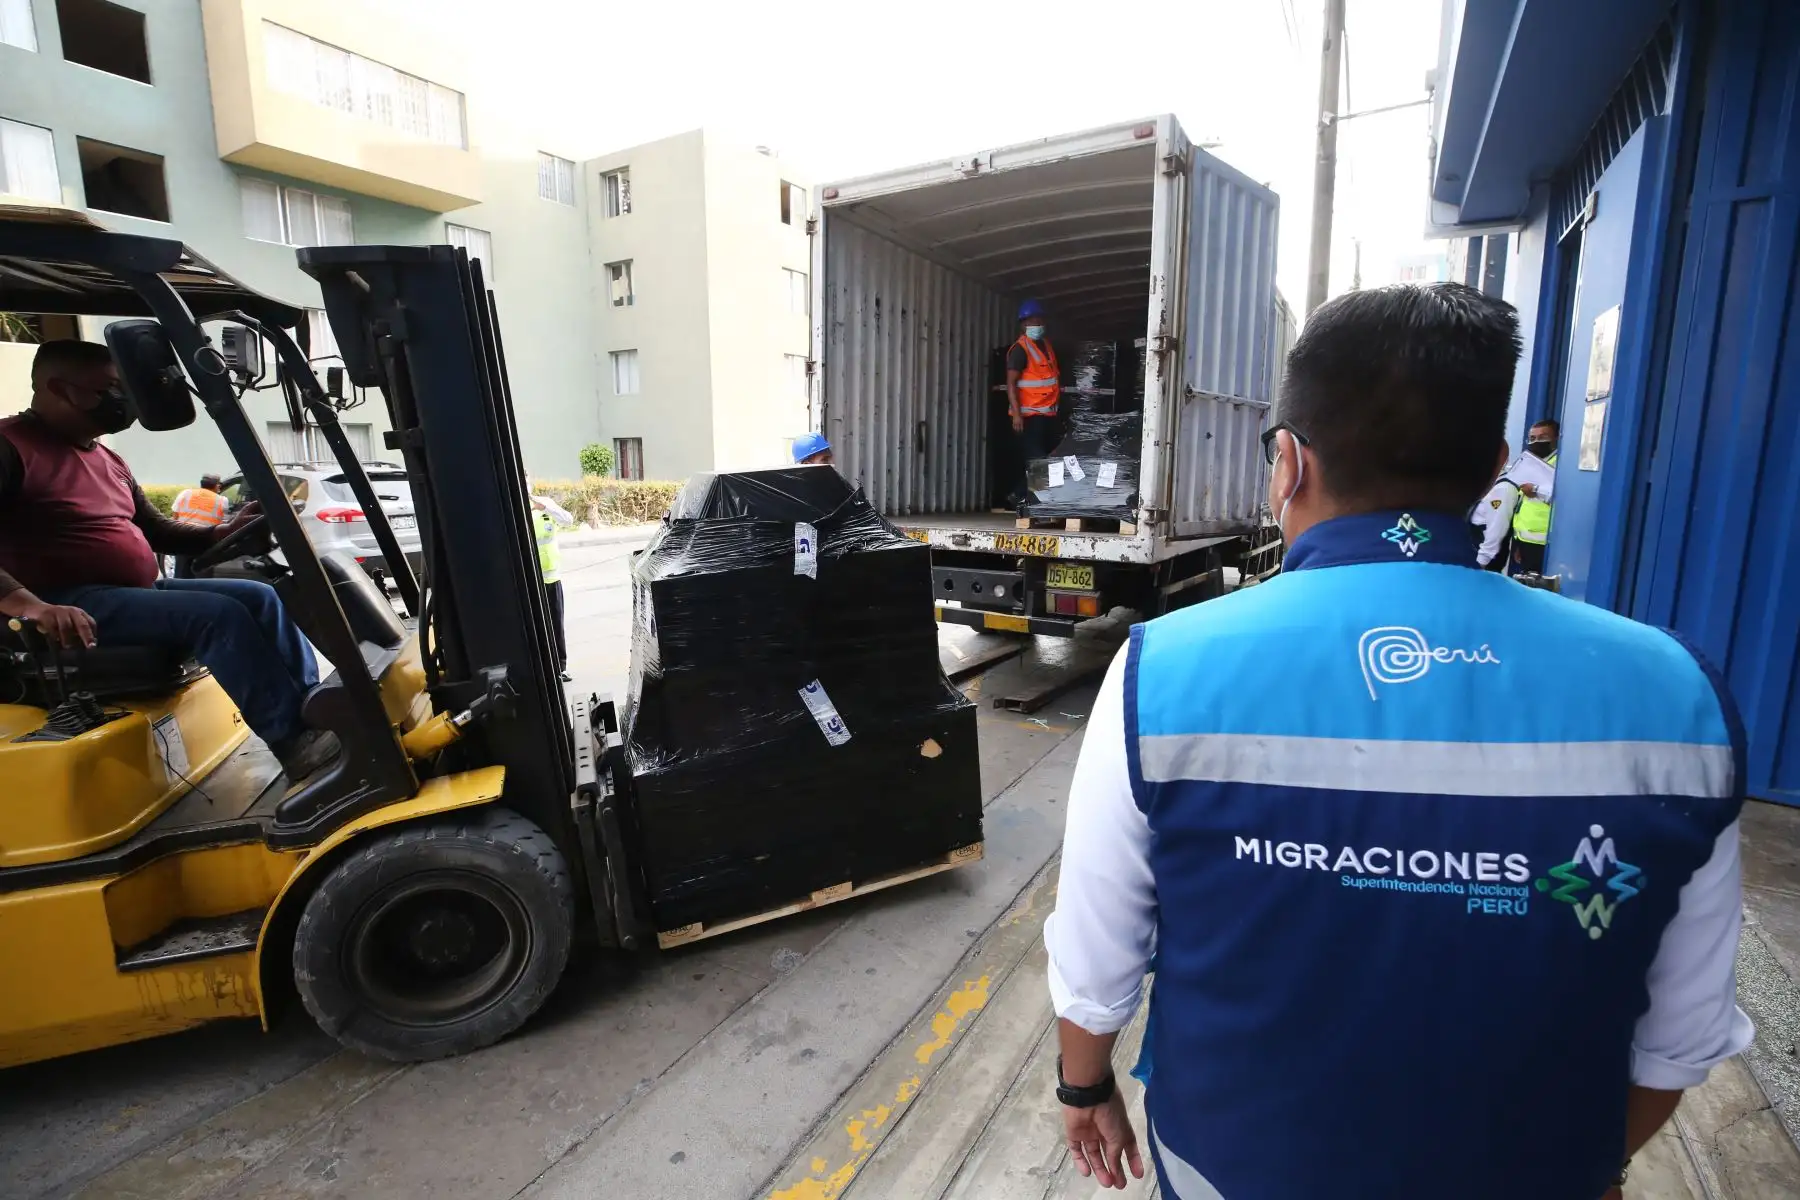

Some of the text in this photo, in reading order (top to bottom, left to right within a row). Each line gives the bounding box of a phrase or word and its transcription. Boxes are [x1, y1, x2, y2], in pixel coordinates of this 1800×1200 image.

[1358, 626, 1501, 702] Perú
[1234, 835, 1531, 883] MIGRACIONES
[1340, 875, 1530, 898] Superintendencia Nacional
[1466, 897, 1528, 915] PERÚ
